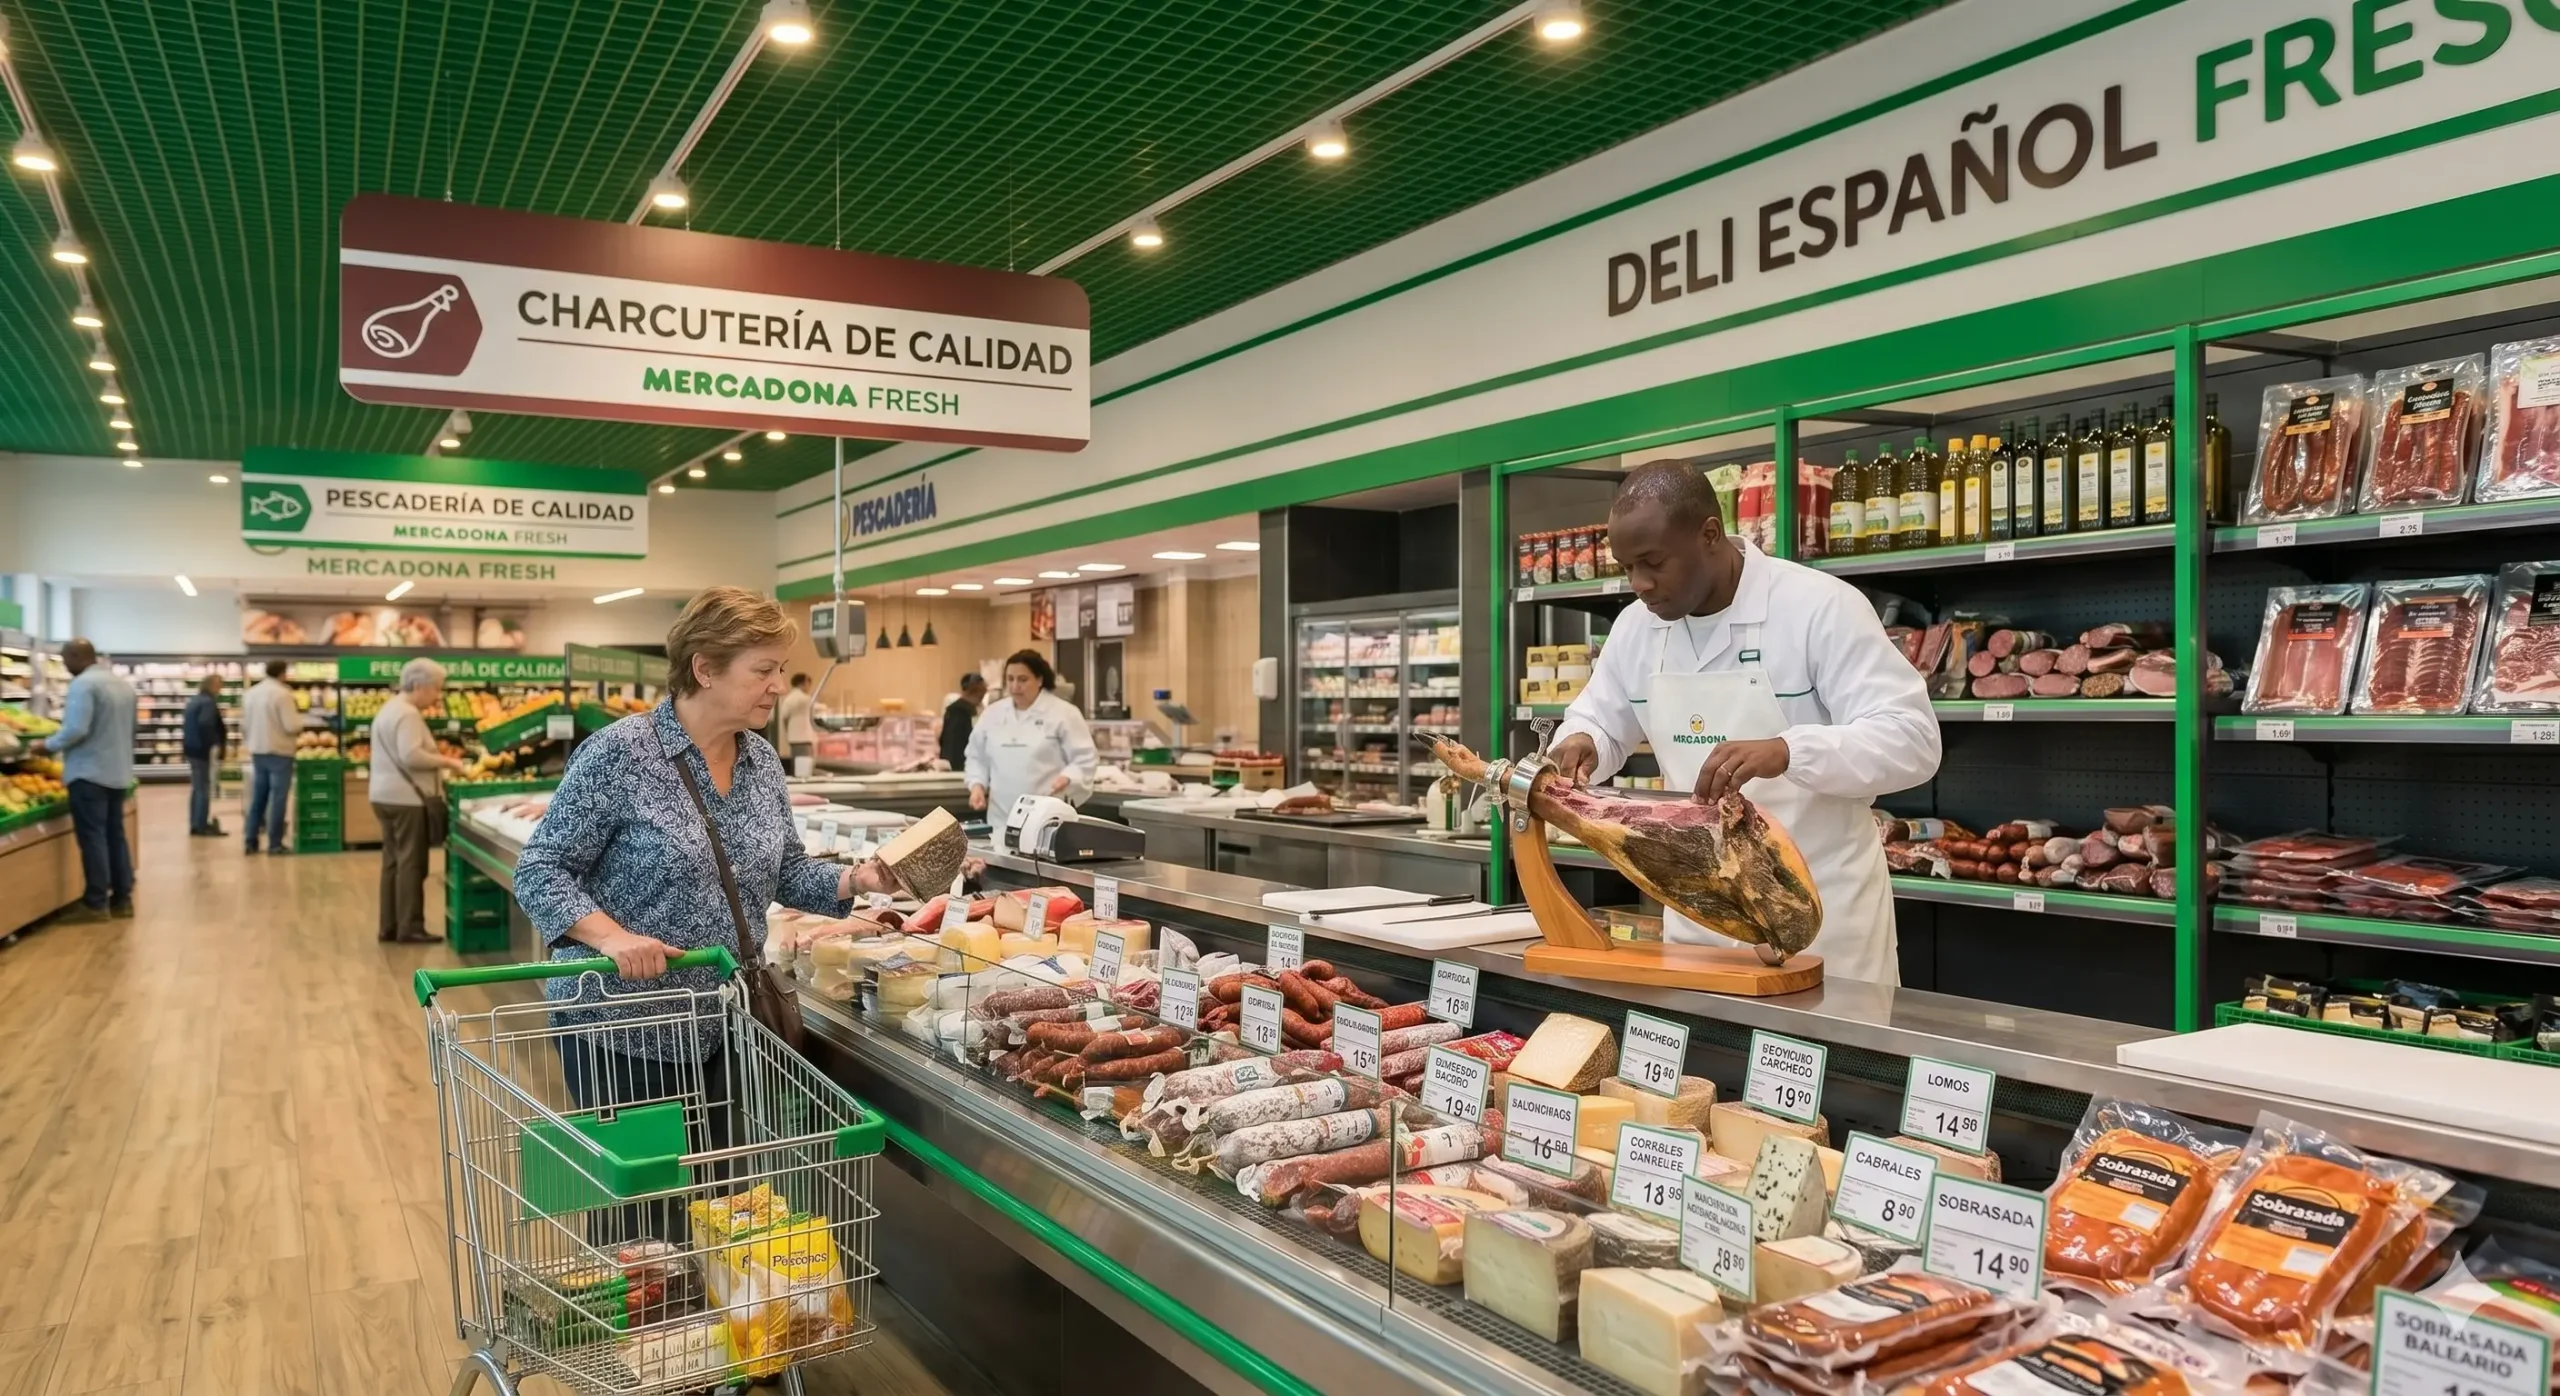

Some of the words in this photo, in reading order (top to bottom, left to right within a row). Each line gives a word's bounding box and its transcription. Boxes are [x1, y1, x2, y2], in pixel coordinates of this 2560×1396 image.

[1608, 216, 1734, 318] DELI
[1758, 84, 2158, 274] ESPAÑOL
[2197, 0, 2560, 144] FRES
[517, 290, 833, 354] CHARCUTERÍA
[846, 323, 897, 360] DE
[909, 331, 1073, 376] CALIDAD
[642, 367, 858, 408] MERCADONA
[868, 386, 960, 416] FRESH
[326, 488, 485, 515] PESCADERÍA
[494, 498, 524, 517] DE
[531, 500, 635, 522] CALIDAD
[852, 472, 937, 537] PESCADERÍA
[393, 524, 509, 542] MERCADONA
[514, 530, 568, 545] FRESH
[306, 557, 470, 579] MERCADONA
[479, 562, 556, 581] FRESH
[478, 661, 501, 678] DE
[1629, 1025, 1681, 1050] MANCHEGO
[1927, 1073, 1970, 1093] LOMOS
[1856, 1151, 1922, 1181] CABRALES
[2096, 1156, 2178, 1188] Sobrasada
[1938, 1193, 2035, 1229] SOBRASADA
[2251, 1193, 2346, 1228] Sobrasada
[2395, 1310, 2529, 1364] SOBRASADA
[2404, 1333, 2513, 1379] BALEARIO
